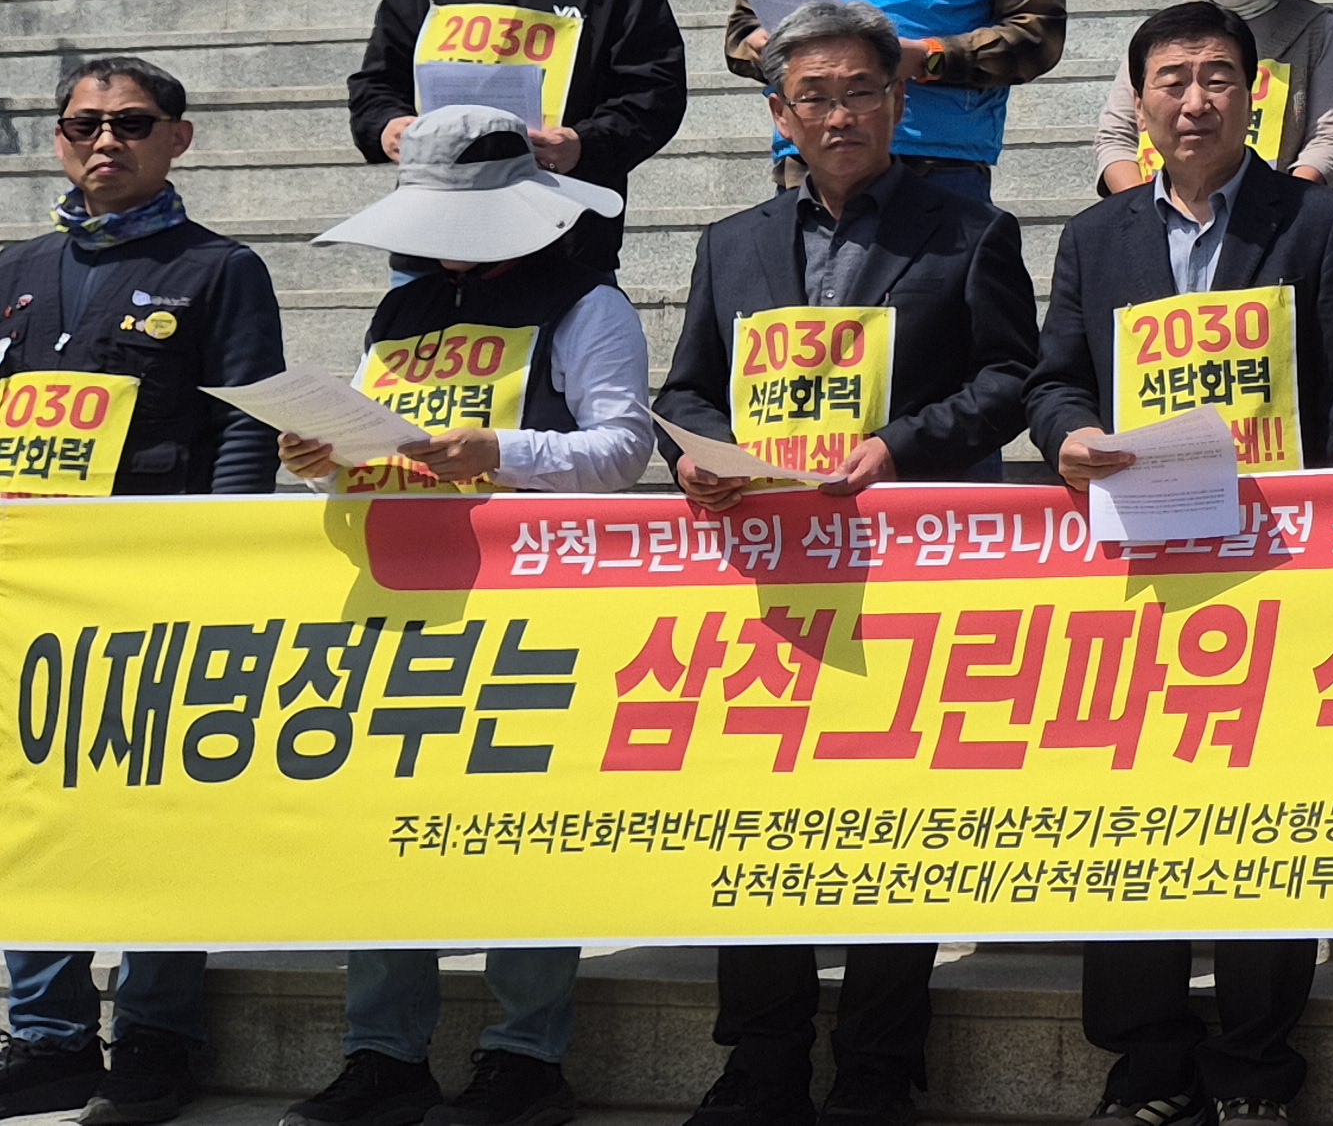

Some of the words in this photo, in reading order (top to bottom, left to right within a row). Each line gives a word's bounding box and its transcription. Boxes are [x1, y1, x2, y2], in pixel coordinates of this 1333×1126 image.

[438, 16, 555, 61] 2030
[742, 319, 865, 376] 2030
[1132, 301, 1270, 365] 2030
[373, 335, 505, 388] 2030
[1138, 356, 1271, 415] 석탄화력
[0, 384, 110, 430] 030
[748, 374, 862, 426] 석탄화력
[0, 435, 95, 481] 탄화력
[509, 515, 781, 576] 삼척그린파워
[801, 507, 1097, 563] 석탄-암모니아
[18, 617, 580, 788] 이재명정부는
[600, 599, 1281, 773] 삼척그린파워
